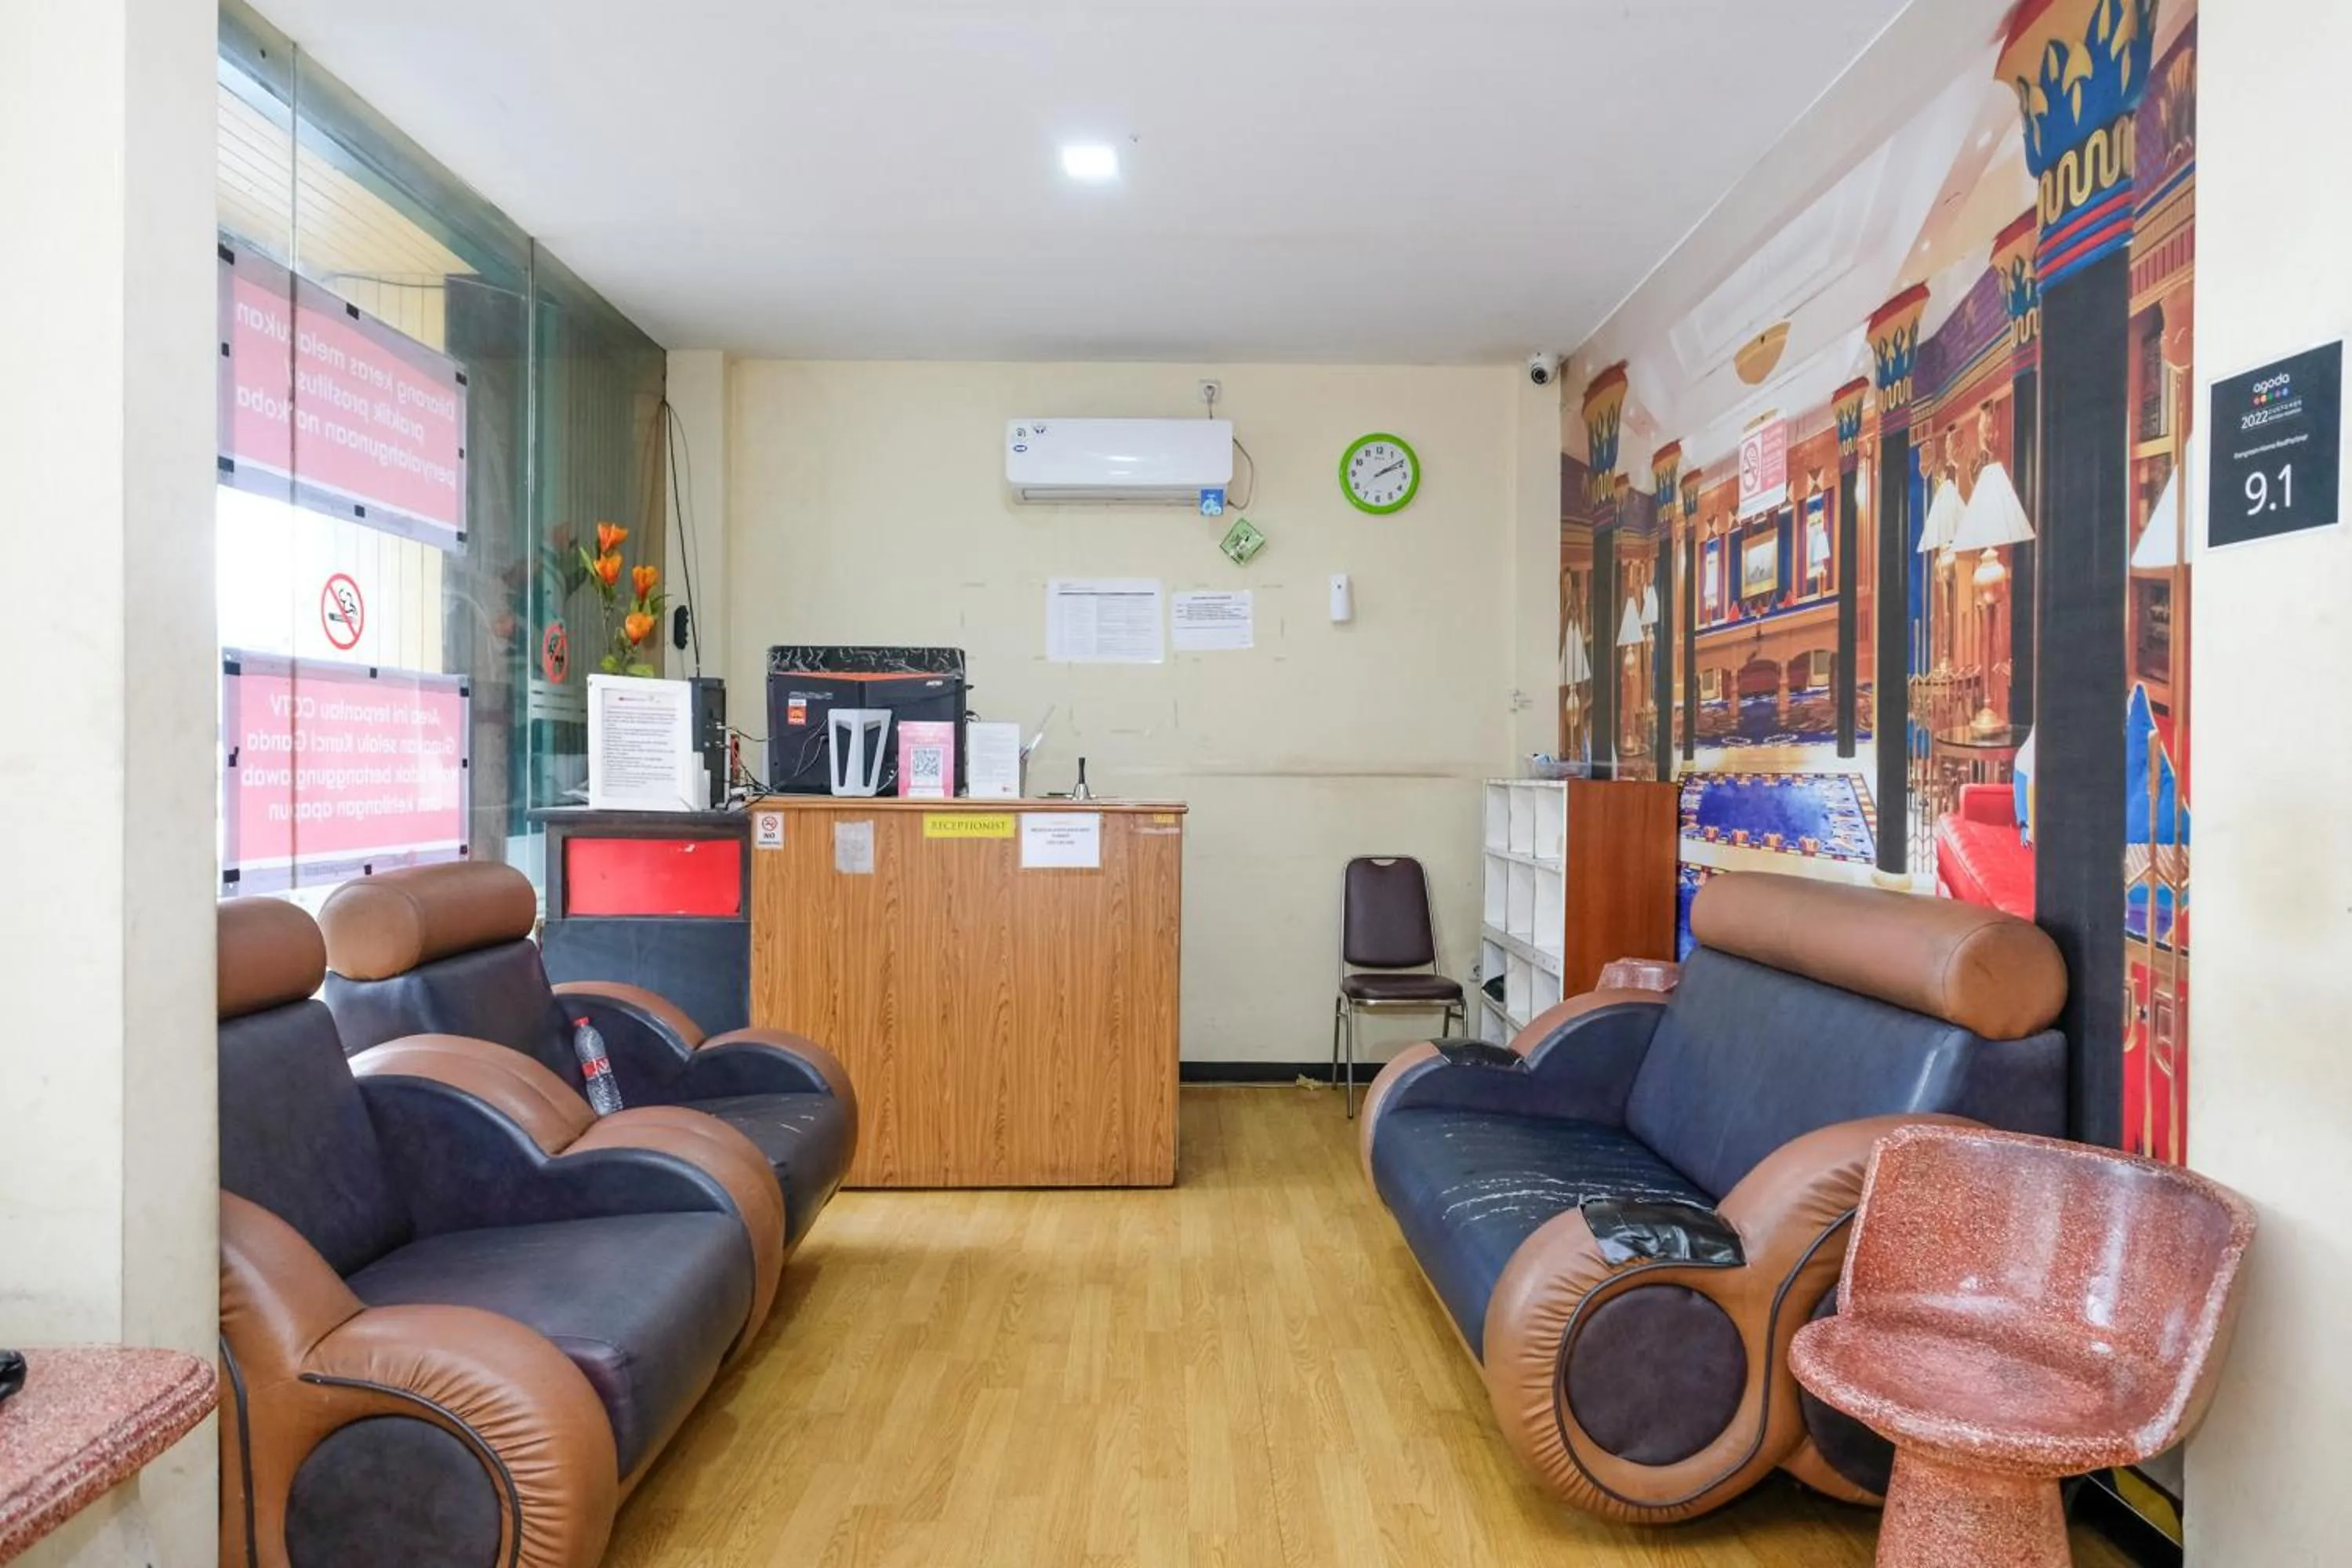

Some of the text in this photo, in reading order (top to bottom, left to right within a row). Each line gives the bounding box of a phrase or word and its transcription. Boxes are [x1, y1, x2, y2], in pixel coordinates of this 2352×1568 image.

[2252, 373, 2290, 393] agoda
[2241, 410, 2269, 430] 2022
[2245, 463, 2292, 516] 9.1
[930, 820, 1006, 831] RECEPTIONIST
